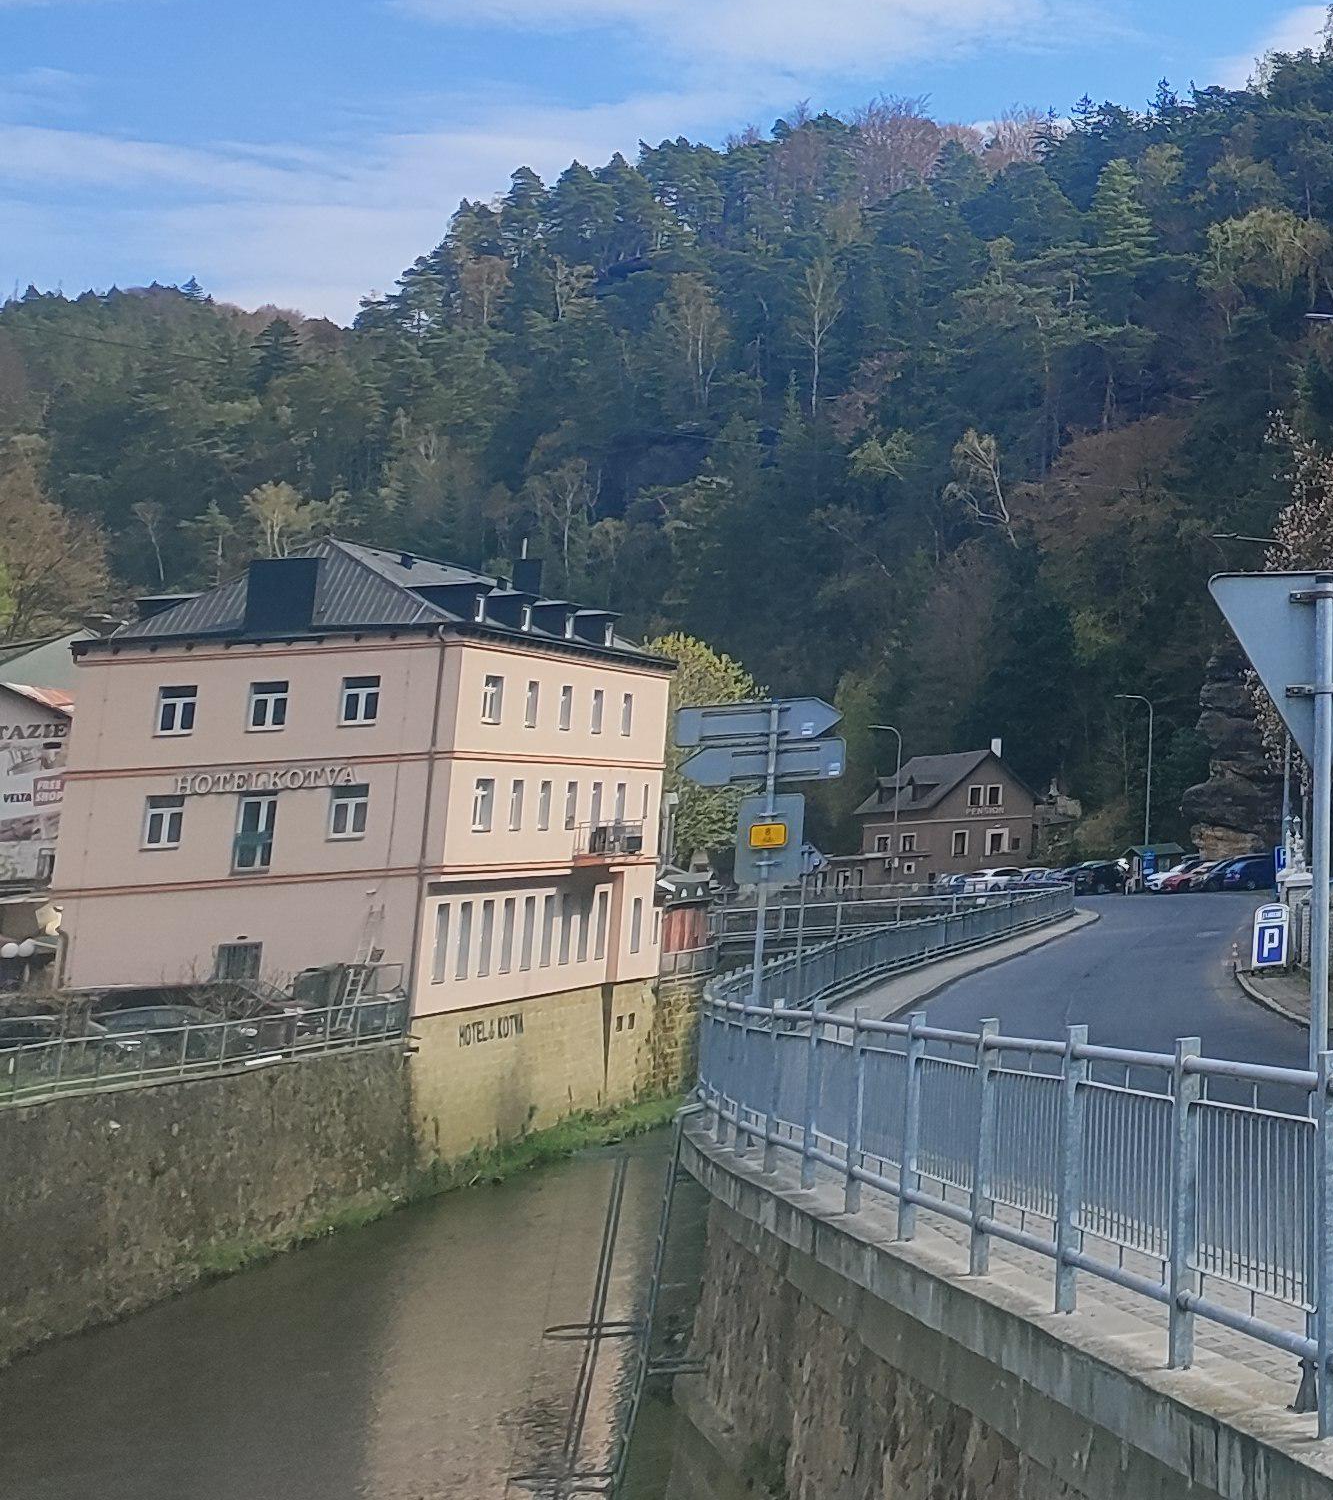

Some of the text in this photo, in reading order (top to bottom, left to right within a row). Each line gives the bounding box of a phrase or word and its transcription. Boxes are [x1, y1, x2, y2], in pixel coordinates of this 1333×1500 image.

[175, 766, 360, 795] HOTEL KOTVA
[1262, 928, 1280, 958] P
